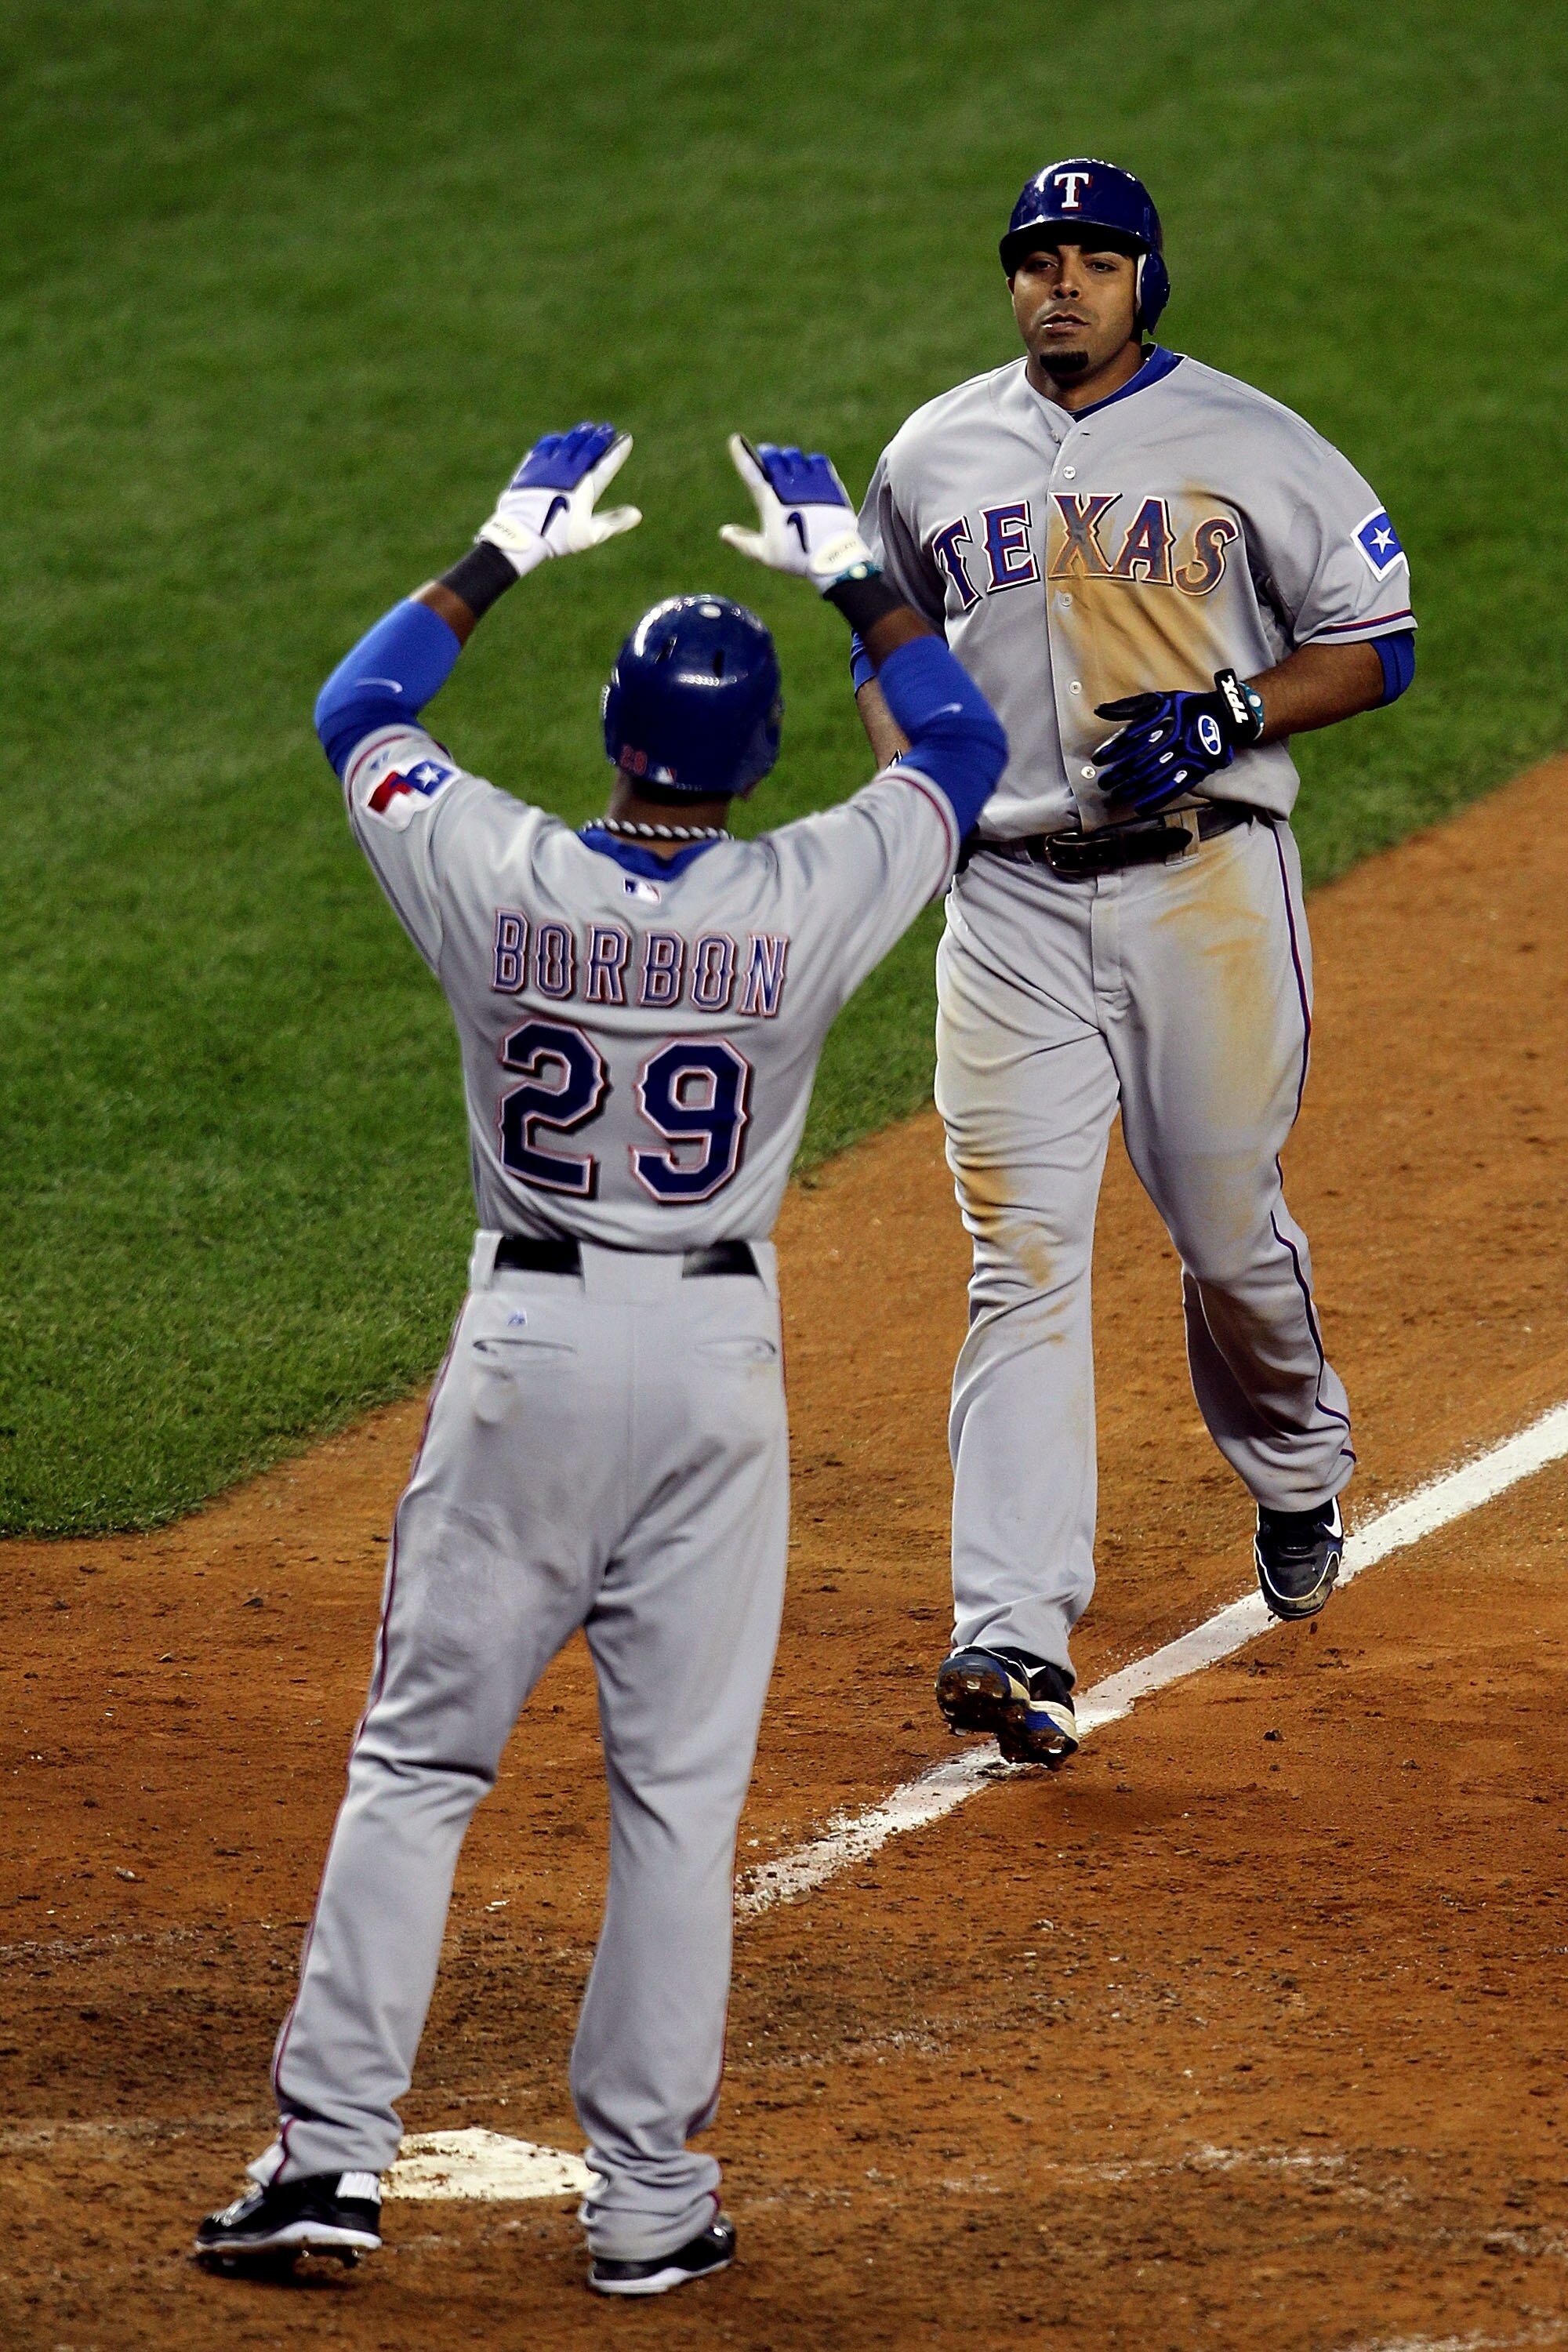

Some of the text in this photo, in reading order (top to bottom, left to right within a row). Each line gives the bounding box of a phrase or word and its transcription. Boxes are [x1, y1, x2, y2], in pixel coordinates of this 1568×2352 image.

[1054, 172, 1093, 212] T
[931, 492, 1240, 611] TEXAS
[1221, 674, 1250, 724] TPX
[492, 908, 789, 1017] BORBON
[498, 1019, 751, 1204] 29
